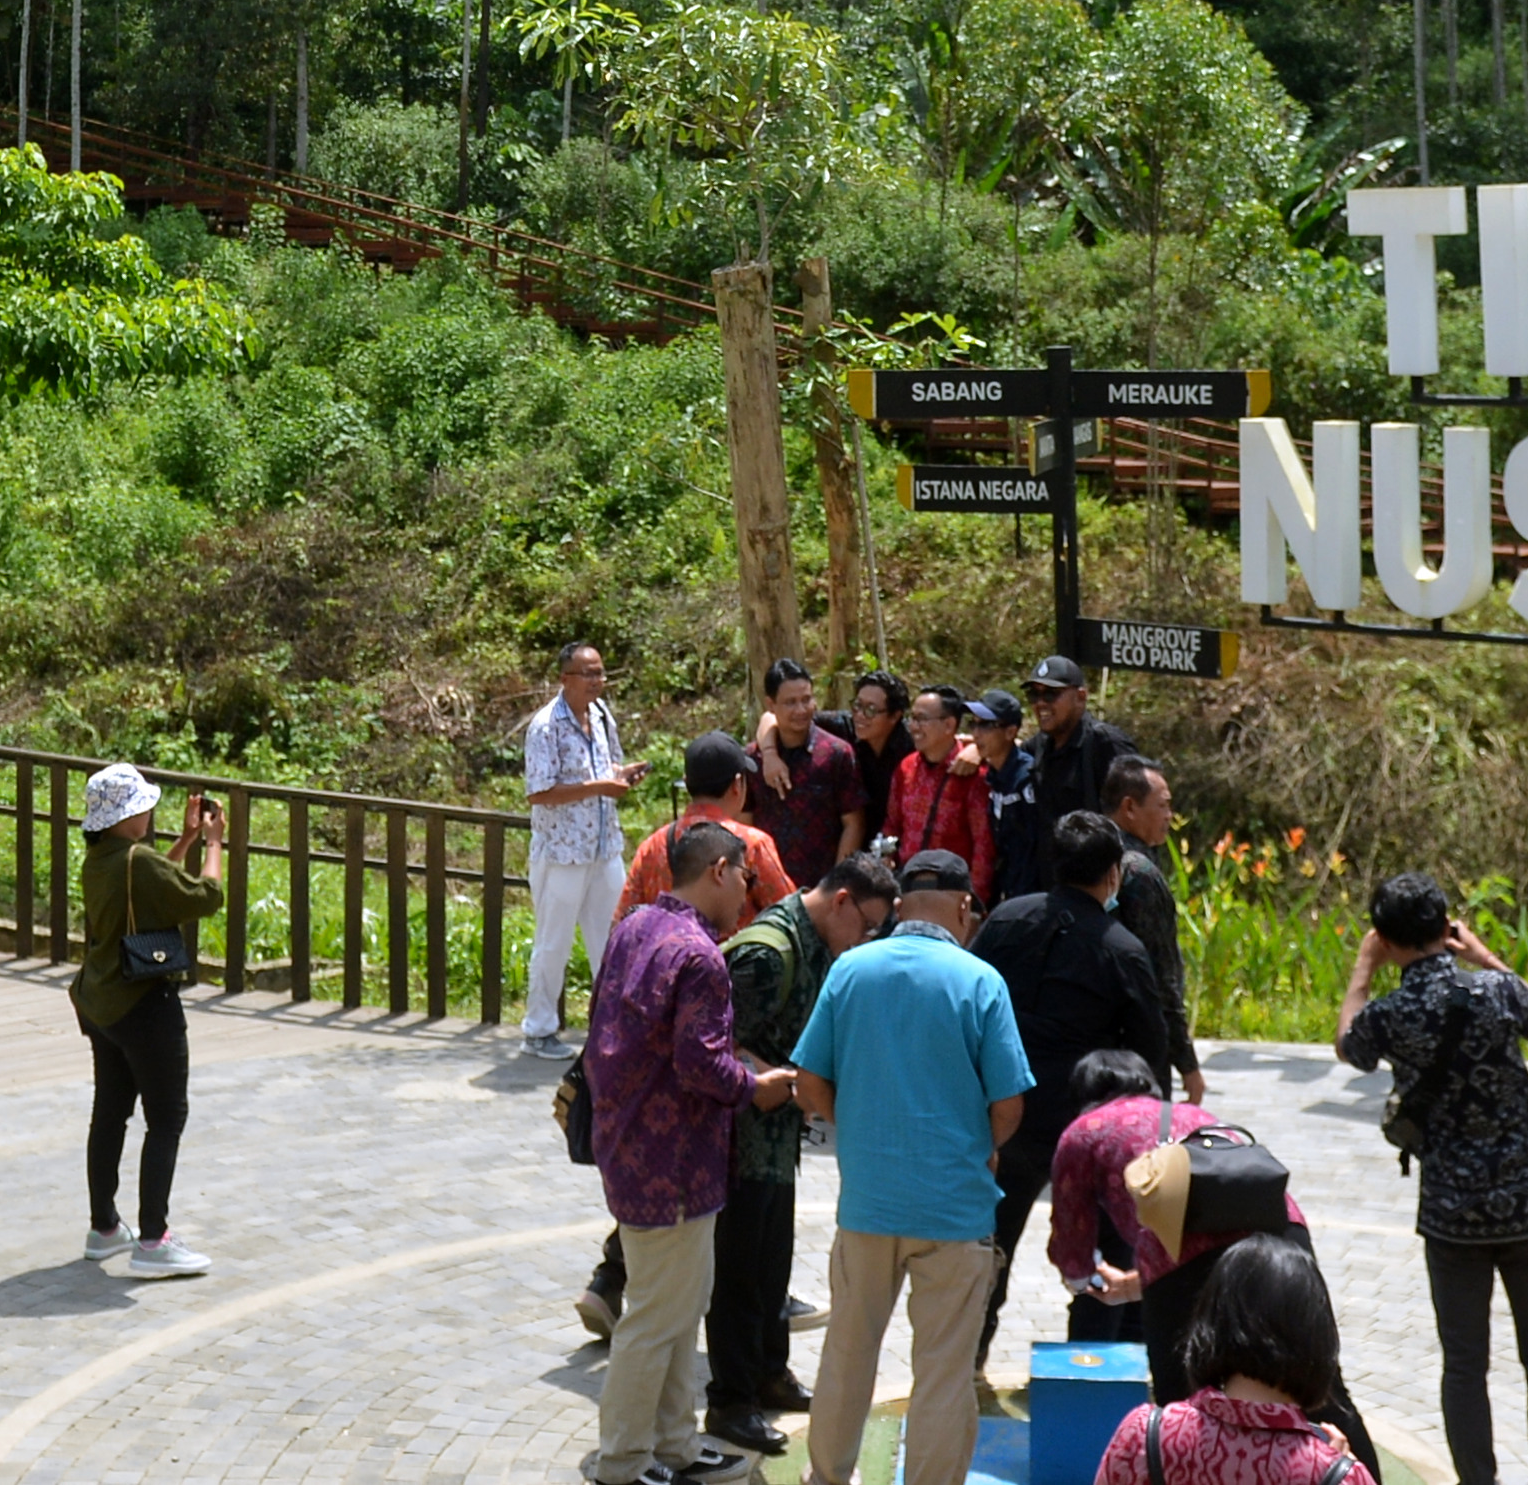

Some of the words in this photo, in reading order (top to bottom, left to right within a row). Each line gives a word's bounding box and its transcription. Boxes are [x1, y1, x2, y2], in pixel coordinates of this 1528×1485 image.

[911, 381, 1003, 402] SABANG
[1108, 383, 1213, 405] MERAUKE
[915, 480, 976, 500] ISTANA
[979, 480, 1049, 501] NEGARA
[1102, 623, 1201, 652] MANGROVE
[1111, 644, 1146, 666] ECO
[1150, 648, 1197, 672] PARK
